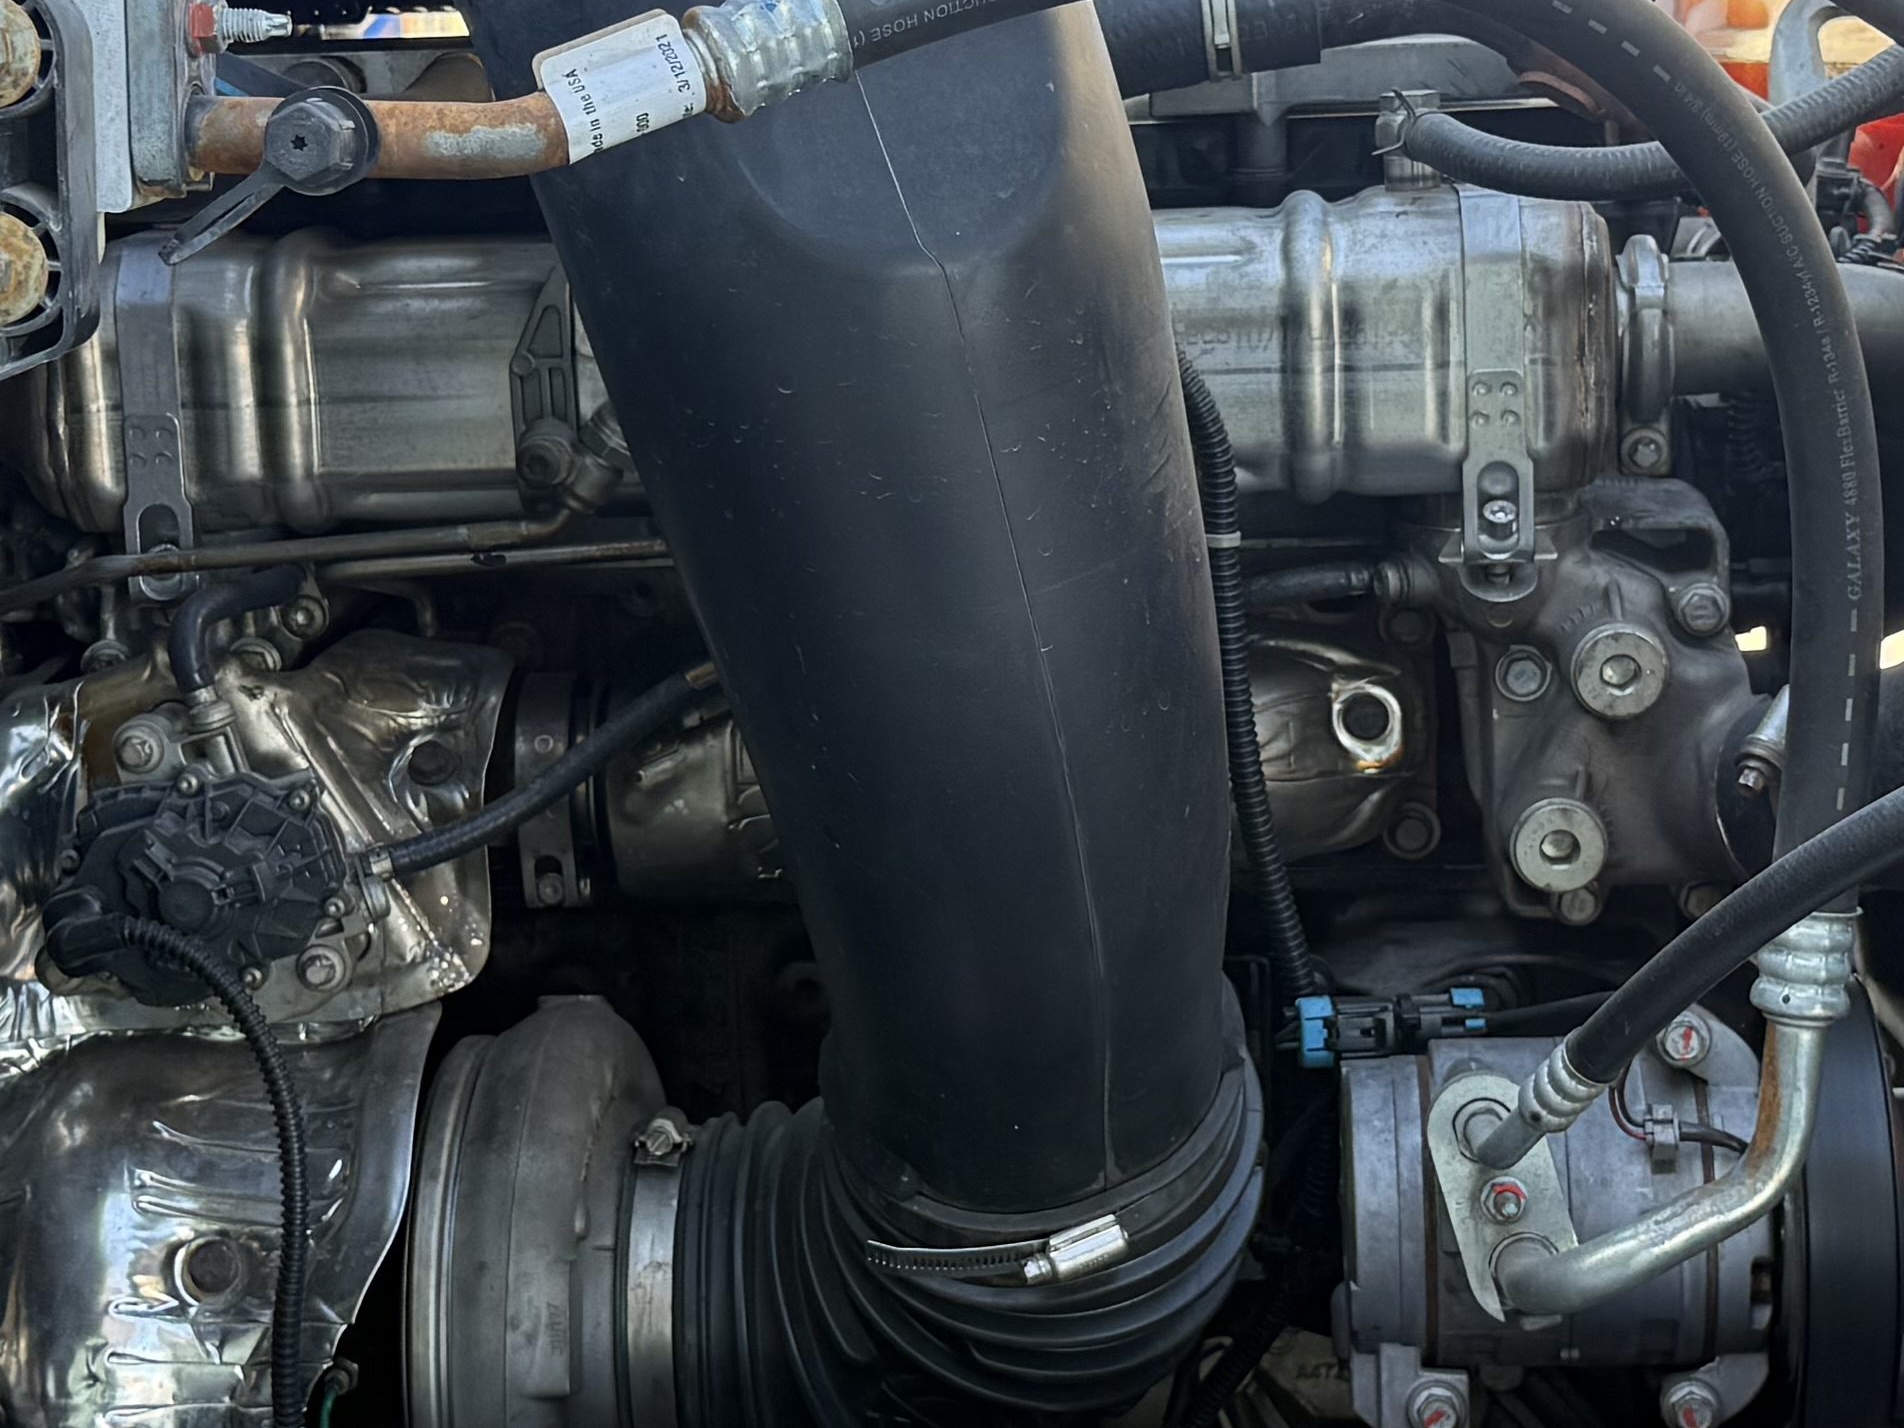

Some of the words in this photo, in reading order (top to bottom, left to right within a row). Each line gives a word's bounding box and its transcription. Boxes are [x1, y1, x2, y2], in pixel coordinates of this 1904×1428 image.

[871, 13, 919, 43] HOSE
[561, 68, 586, 94] USA
[655, 33, 692, 94] 3/12/2021
[580, 93, 597, 116] the
[589, 118, 602, 132] in
[1730, 149, 1762, 193] HOSE
[1754, 186, 1794, 245] SUCTION
[1845, 511, 1863, 601] GALAXY
